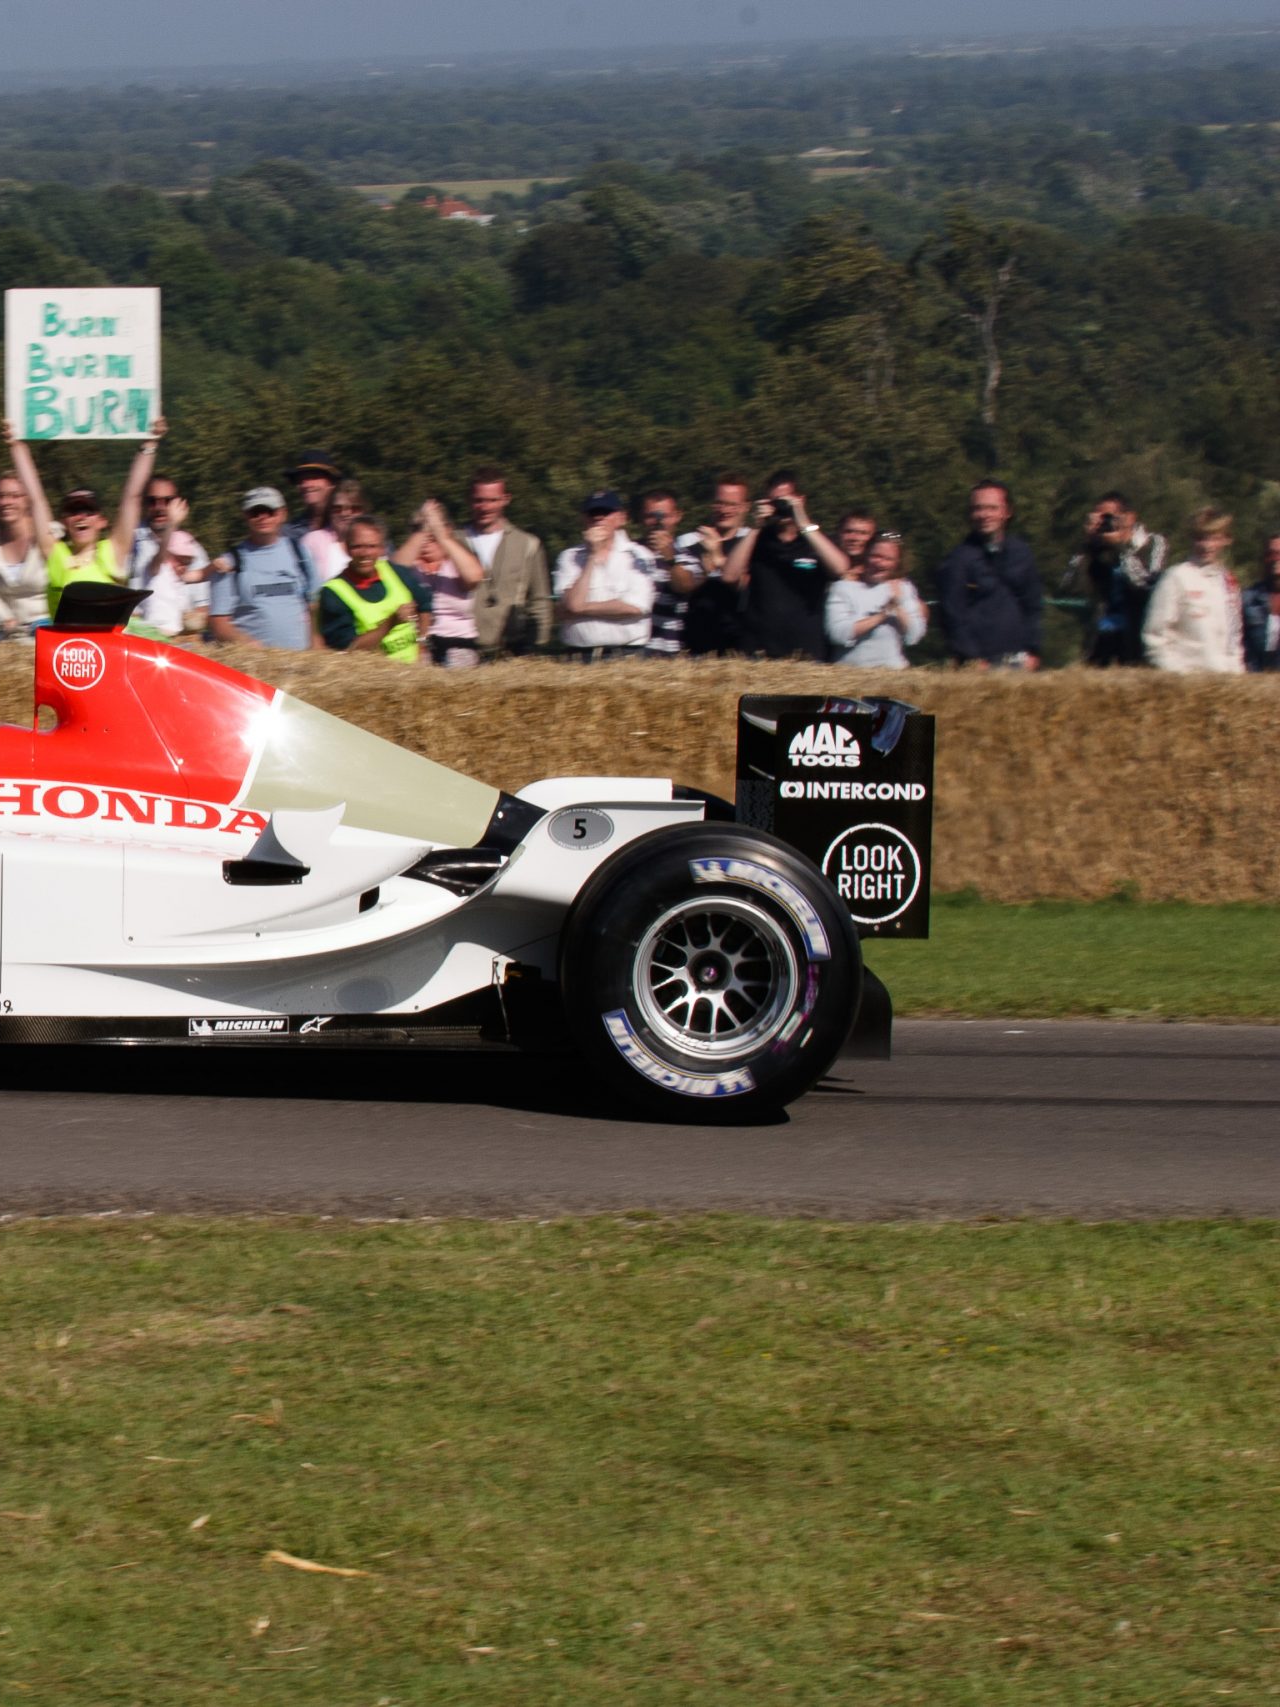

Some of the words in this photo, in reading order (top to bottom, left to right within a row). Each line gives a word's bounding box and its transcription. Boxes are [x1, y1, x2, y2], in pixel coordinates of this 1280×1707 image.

[62, 647, 96, 663] LOOK
[60, 663, 98, 679] RIGHT
[788, 755, 861, 768] TOOLS
[806, 781, 926, 801] INTERCOND
[573, 818, 587, 840] 5
[841, 845, 903, 871] LOOK
[838, 874, 906, 900] RIGHT
[214, 1020, 285, 1031] MICHELIN
